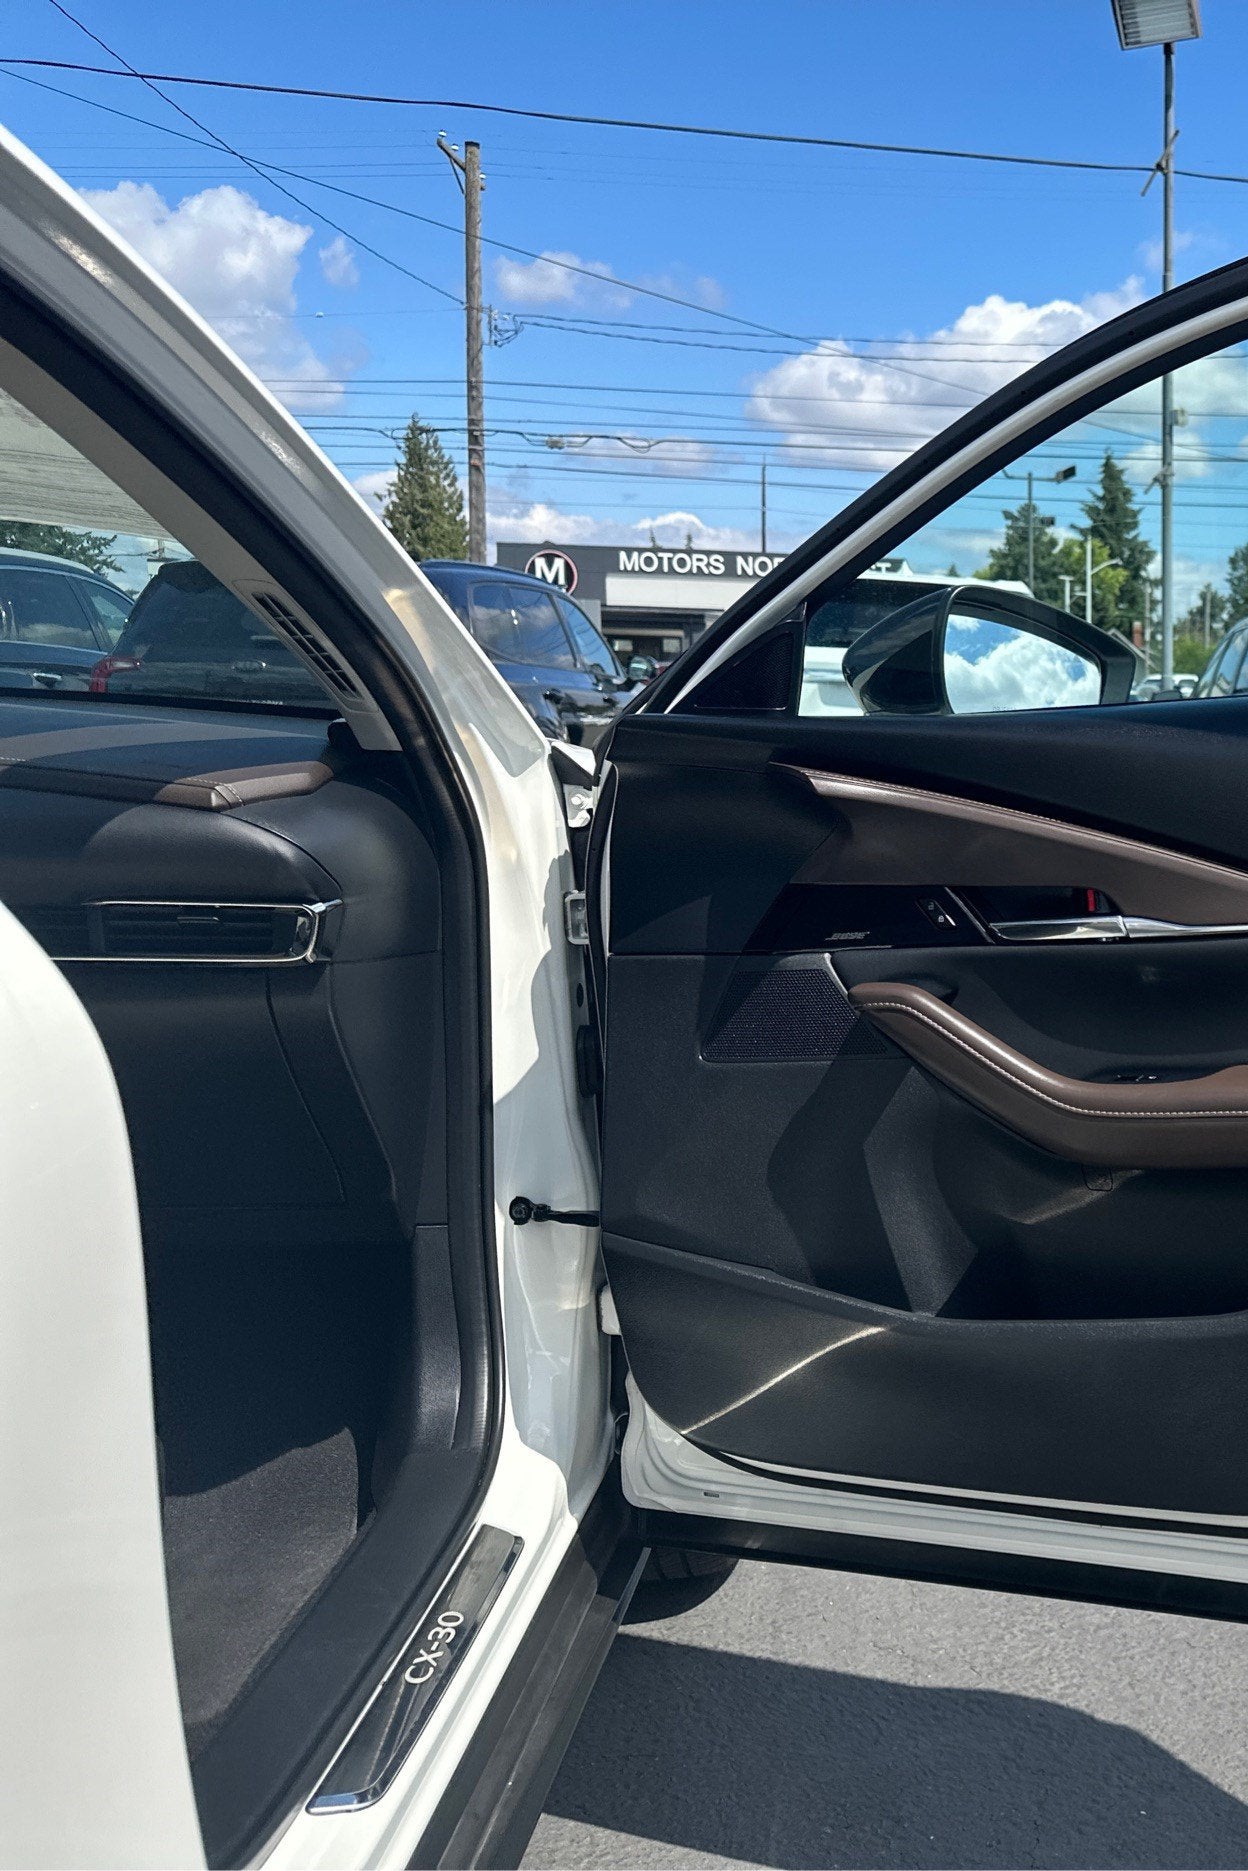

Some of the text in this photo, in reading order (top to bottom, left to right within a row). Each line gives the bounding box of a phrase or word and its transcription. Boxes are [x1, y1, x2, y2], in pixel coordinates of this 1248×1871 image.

[534, 556, 566, 586] M
[618, 550, 726, 575] MOTORS
[404, 1611, 465, 1684] CX-30
